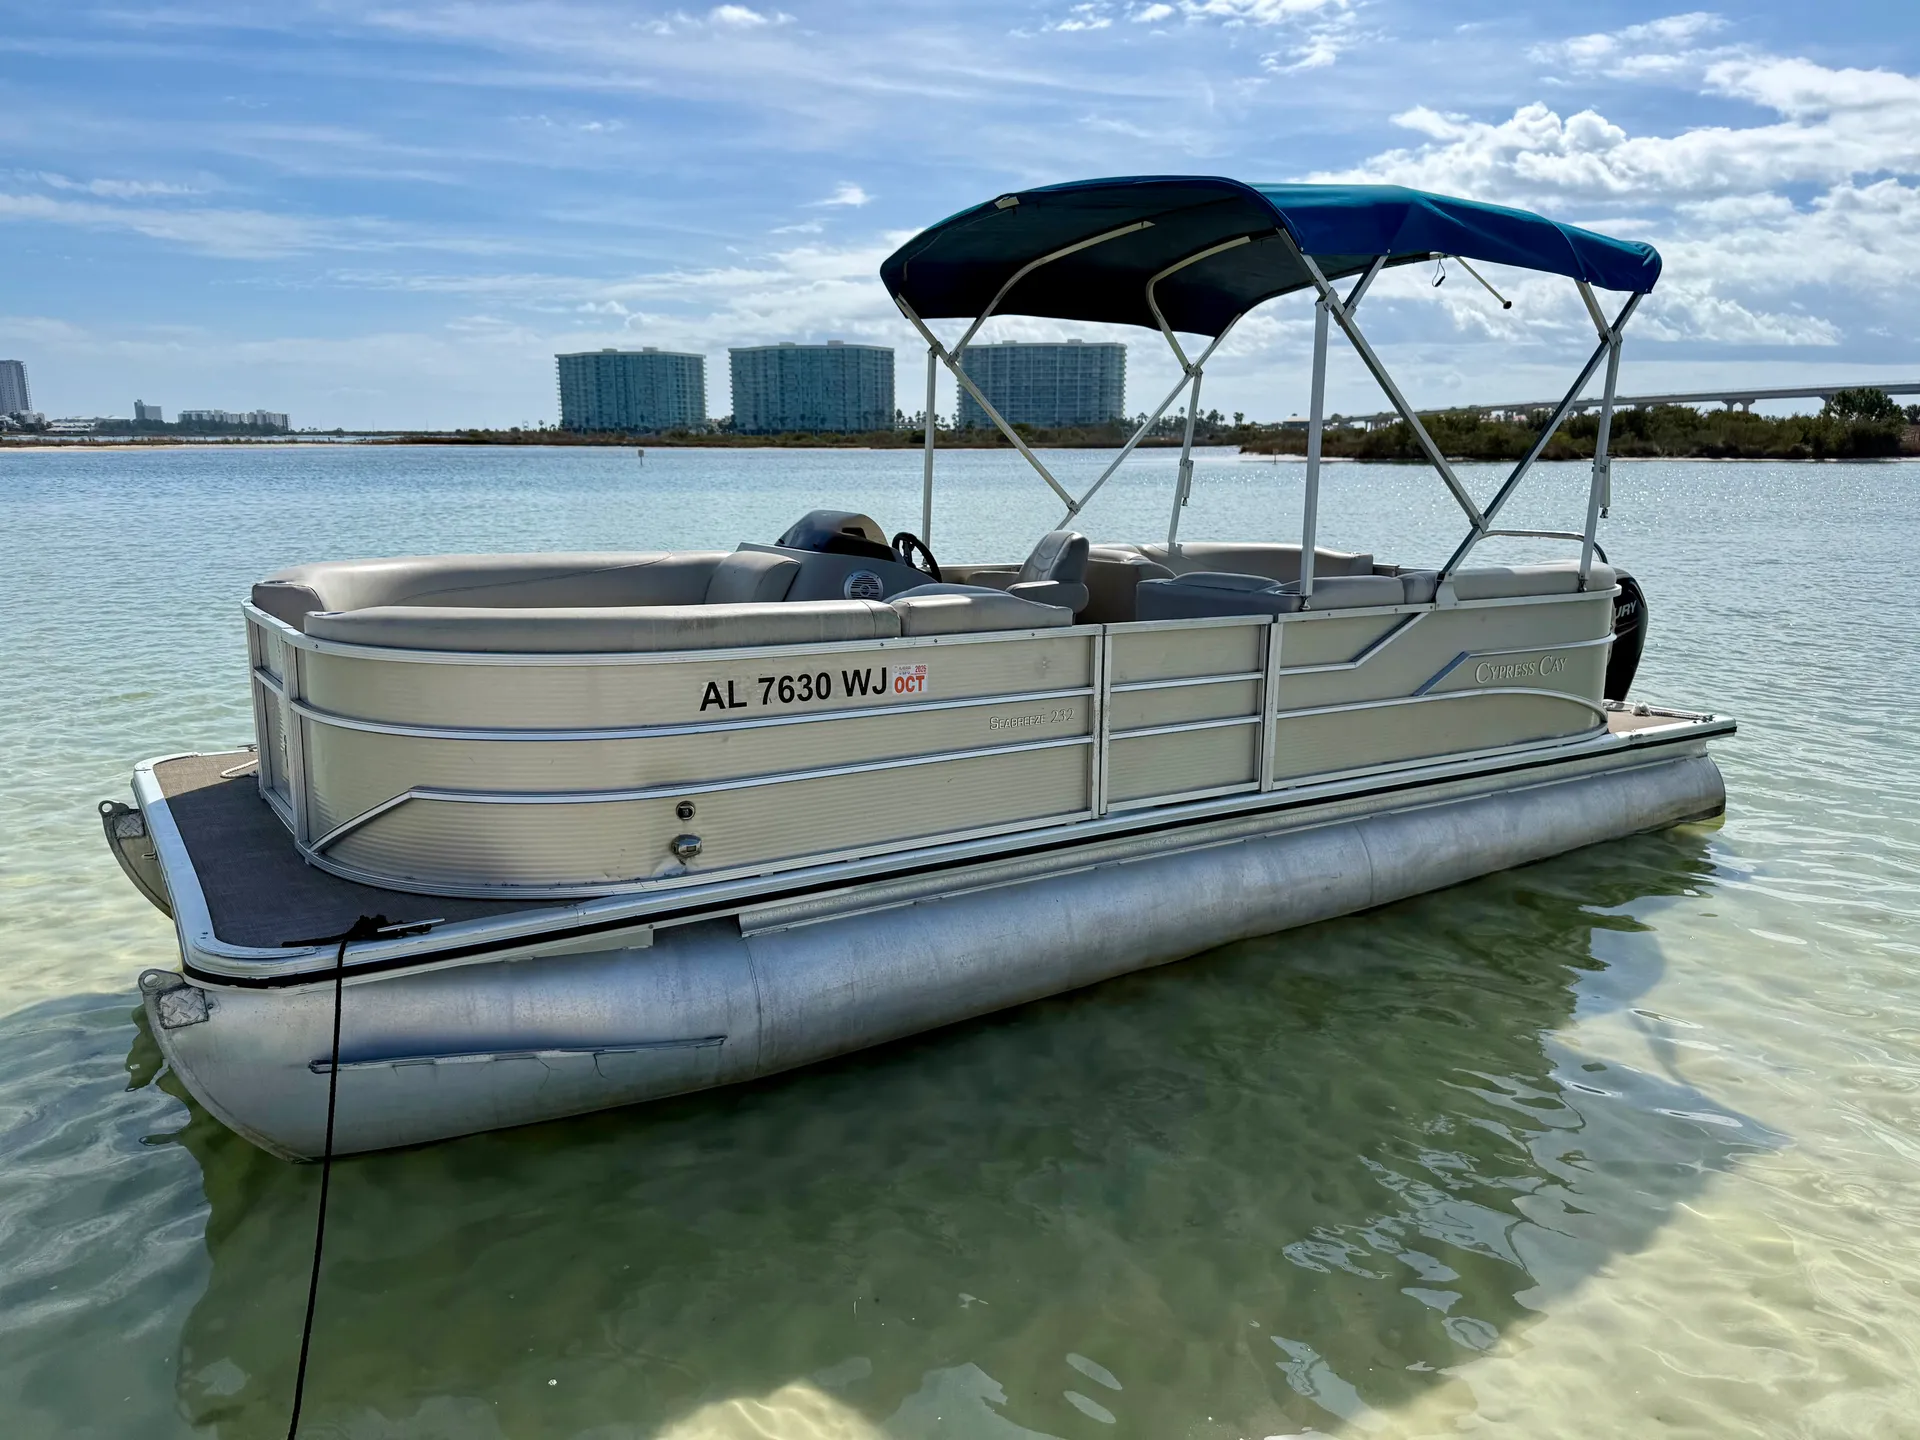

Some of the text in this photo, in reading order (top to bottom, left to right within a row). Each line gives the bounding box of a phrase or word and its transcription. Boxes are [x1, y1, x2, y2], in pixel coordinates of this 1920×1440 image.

[1475, 654, 1568, 684] CYPRESS CAY
[700, 667, 887, 711] AL 7630 WJ
[894, 675, 925, 694] OCT
[1050, 708, 1075, 723] 232
